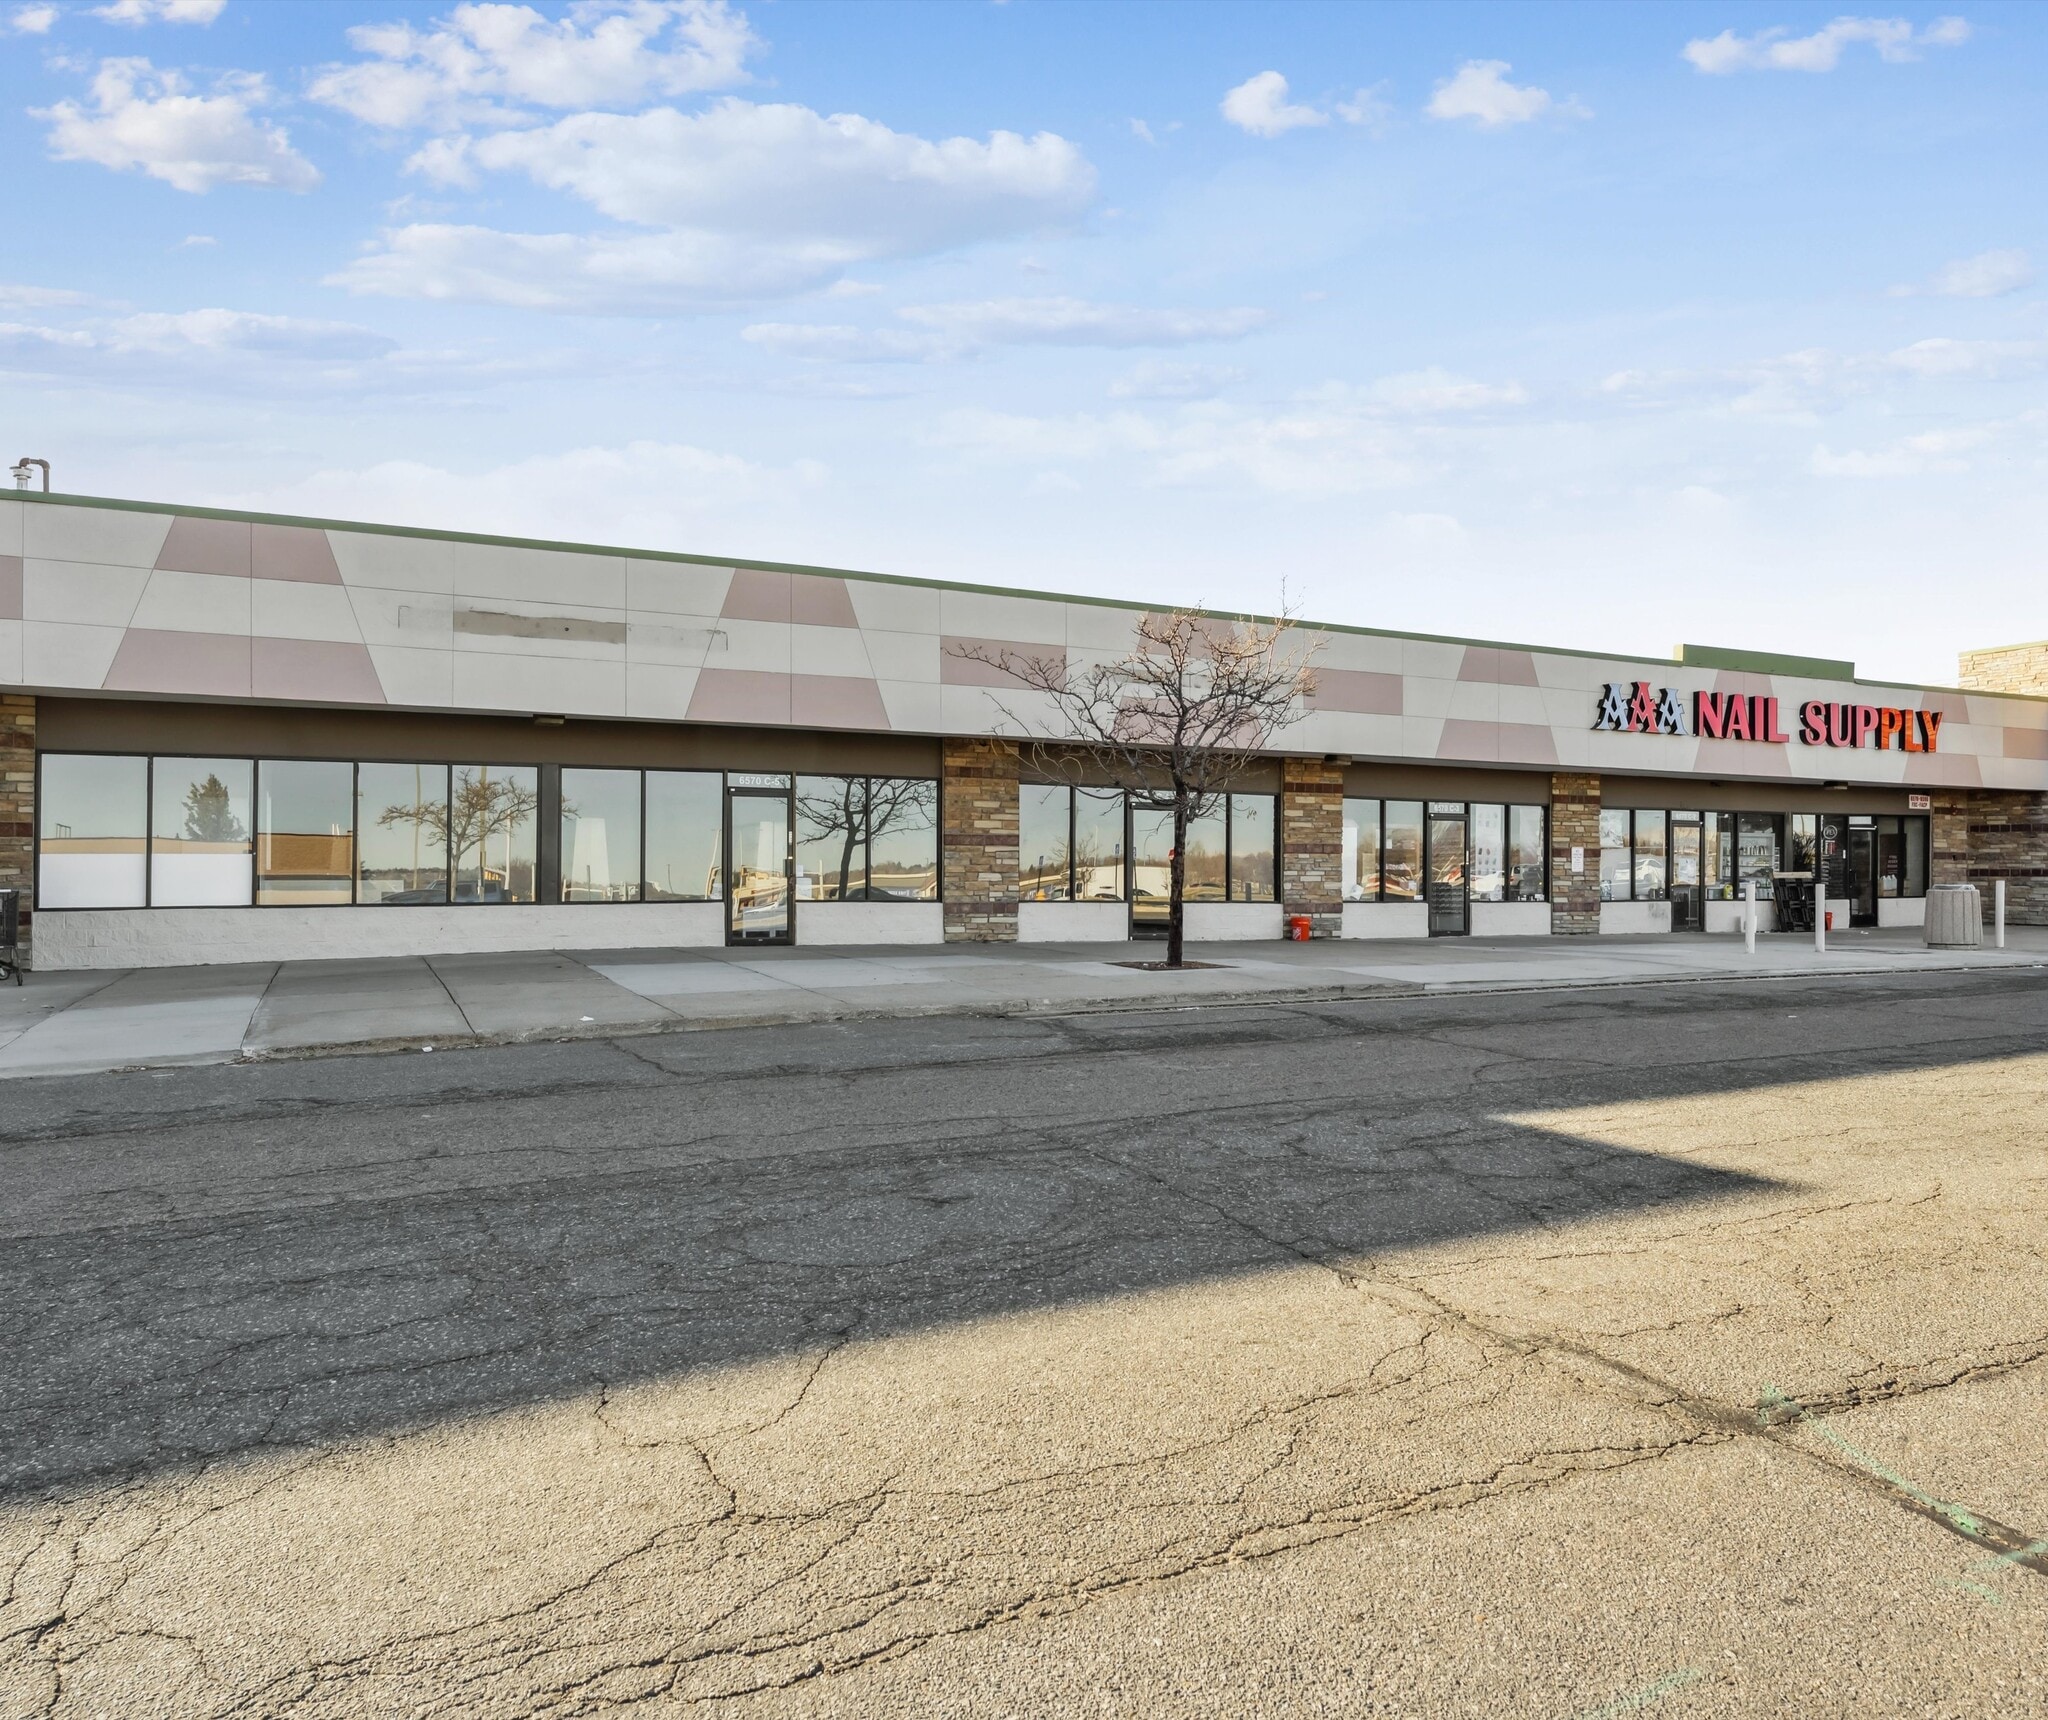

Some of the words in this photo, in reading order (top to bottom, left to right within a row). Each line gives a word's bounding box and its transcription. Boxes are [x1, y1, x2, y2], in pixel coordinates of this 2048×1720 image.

[1592, 681, 1689, 735] AAA
[1693, 690, 1790, 743] NAIL
[1799, 700, 1943, 753] SUPPLY
[739, 776, 762, 785] 6570
[764, 777, 780, 786] C-5
